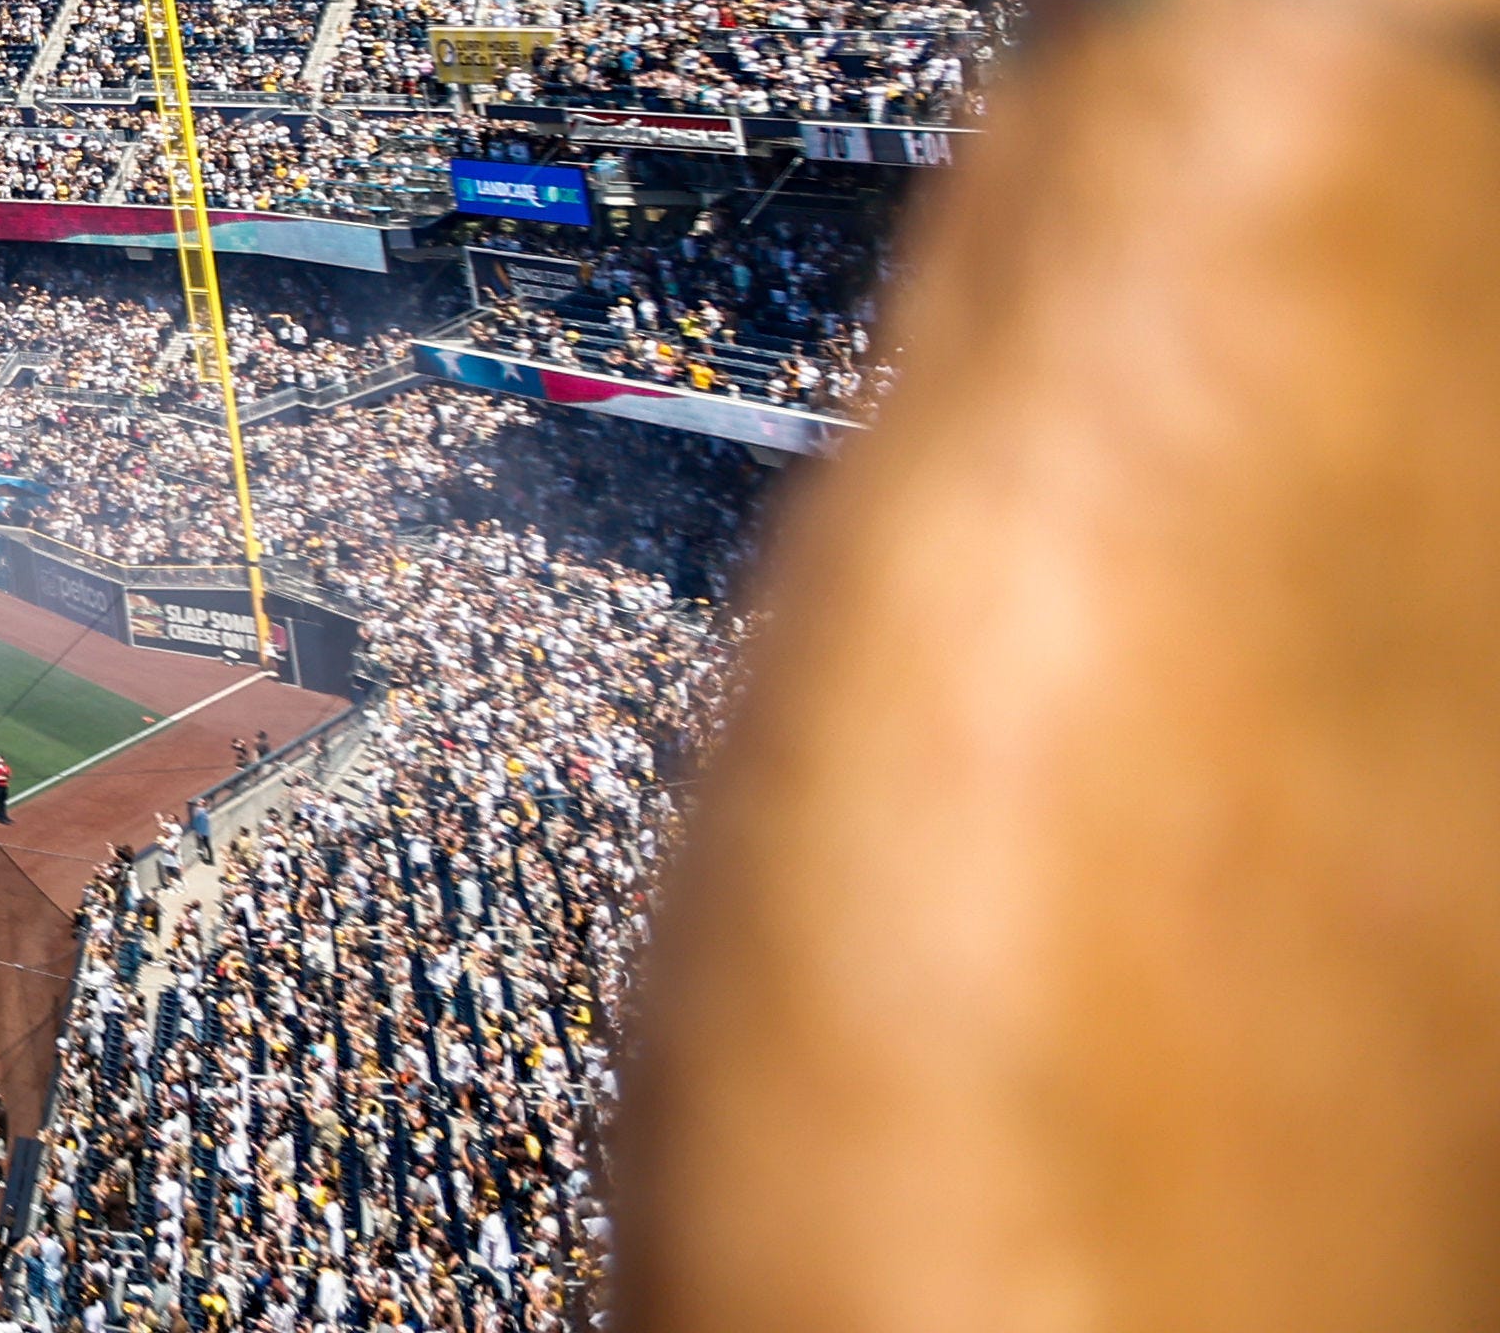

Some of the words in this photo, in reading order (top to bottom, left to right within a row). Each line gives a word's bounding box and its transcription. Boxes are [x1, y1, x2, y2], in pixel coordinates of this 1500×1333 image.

[60, 575, 107, 613] petco
[164, 604, 208, 627] SLAP
[167, 623, 222, 646] CHEESE
[222, 631, 245, 650] ON
